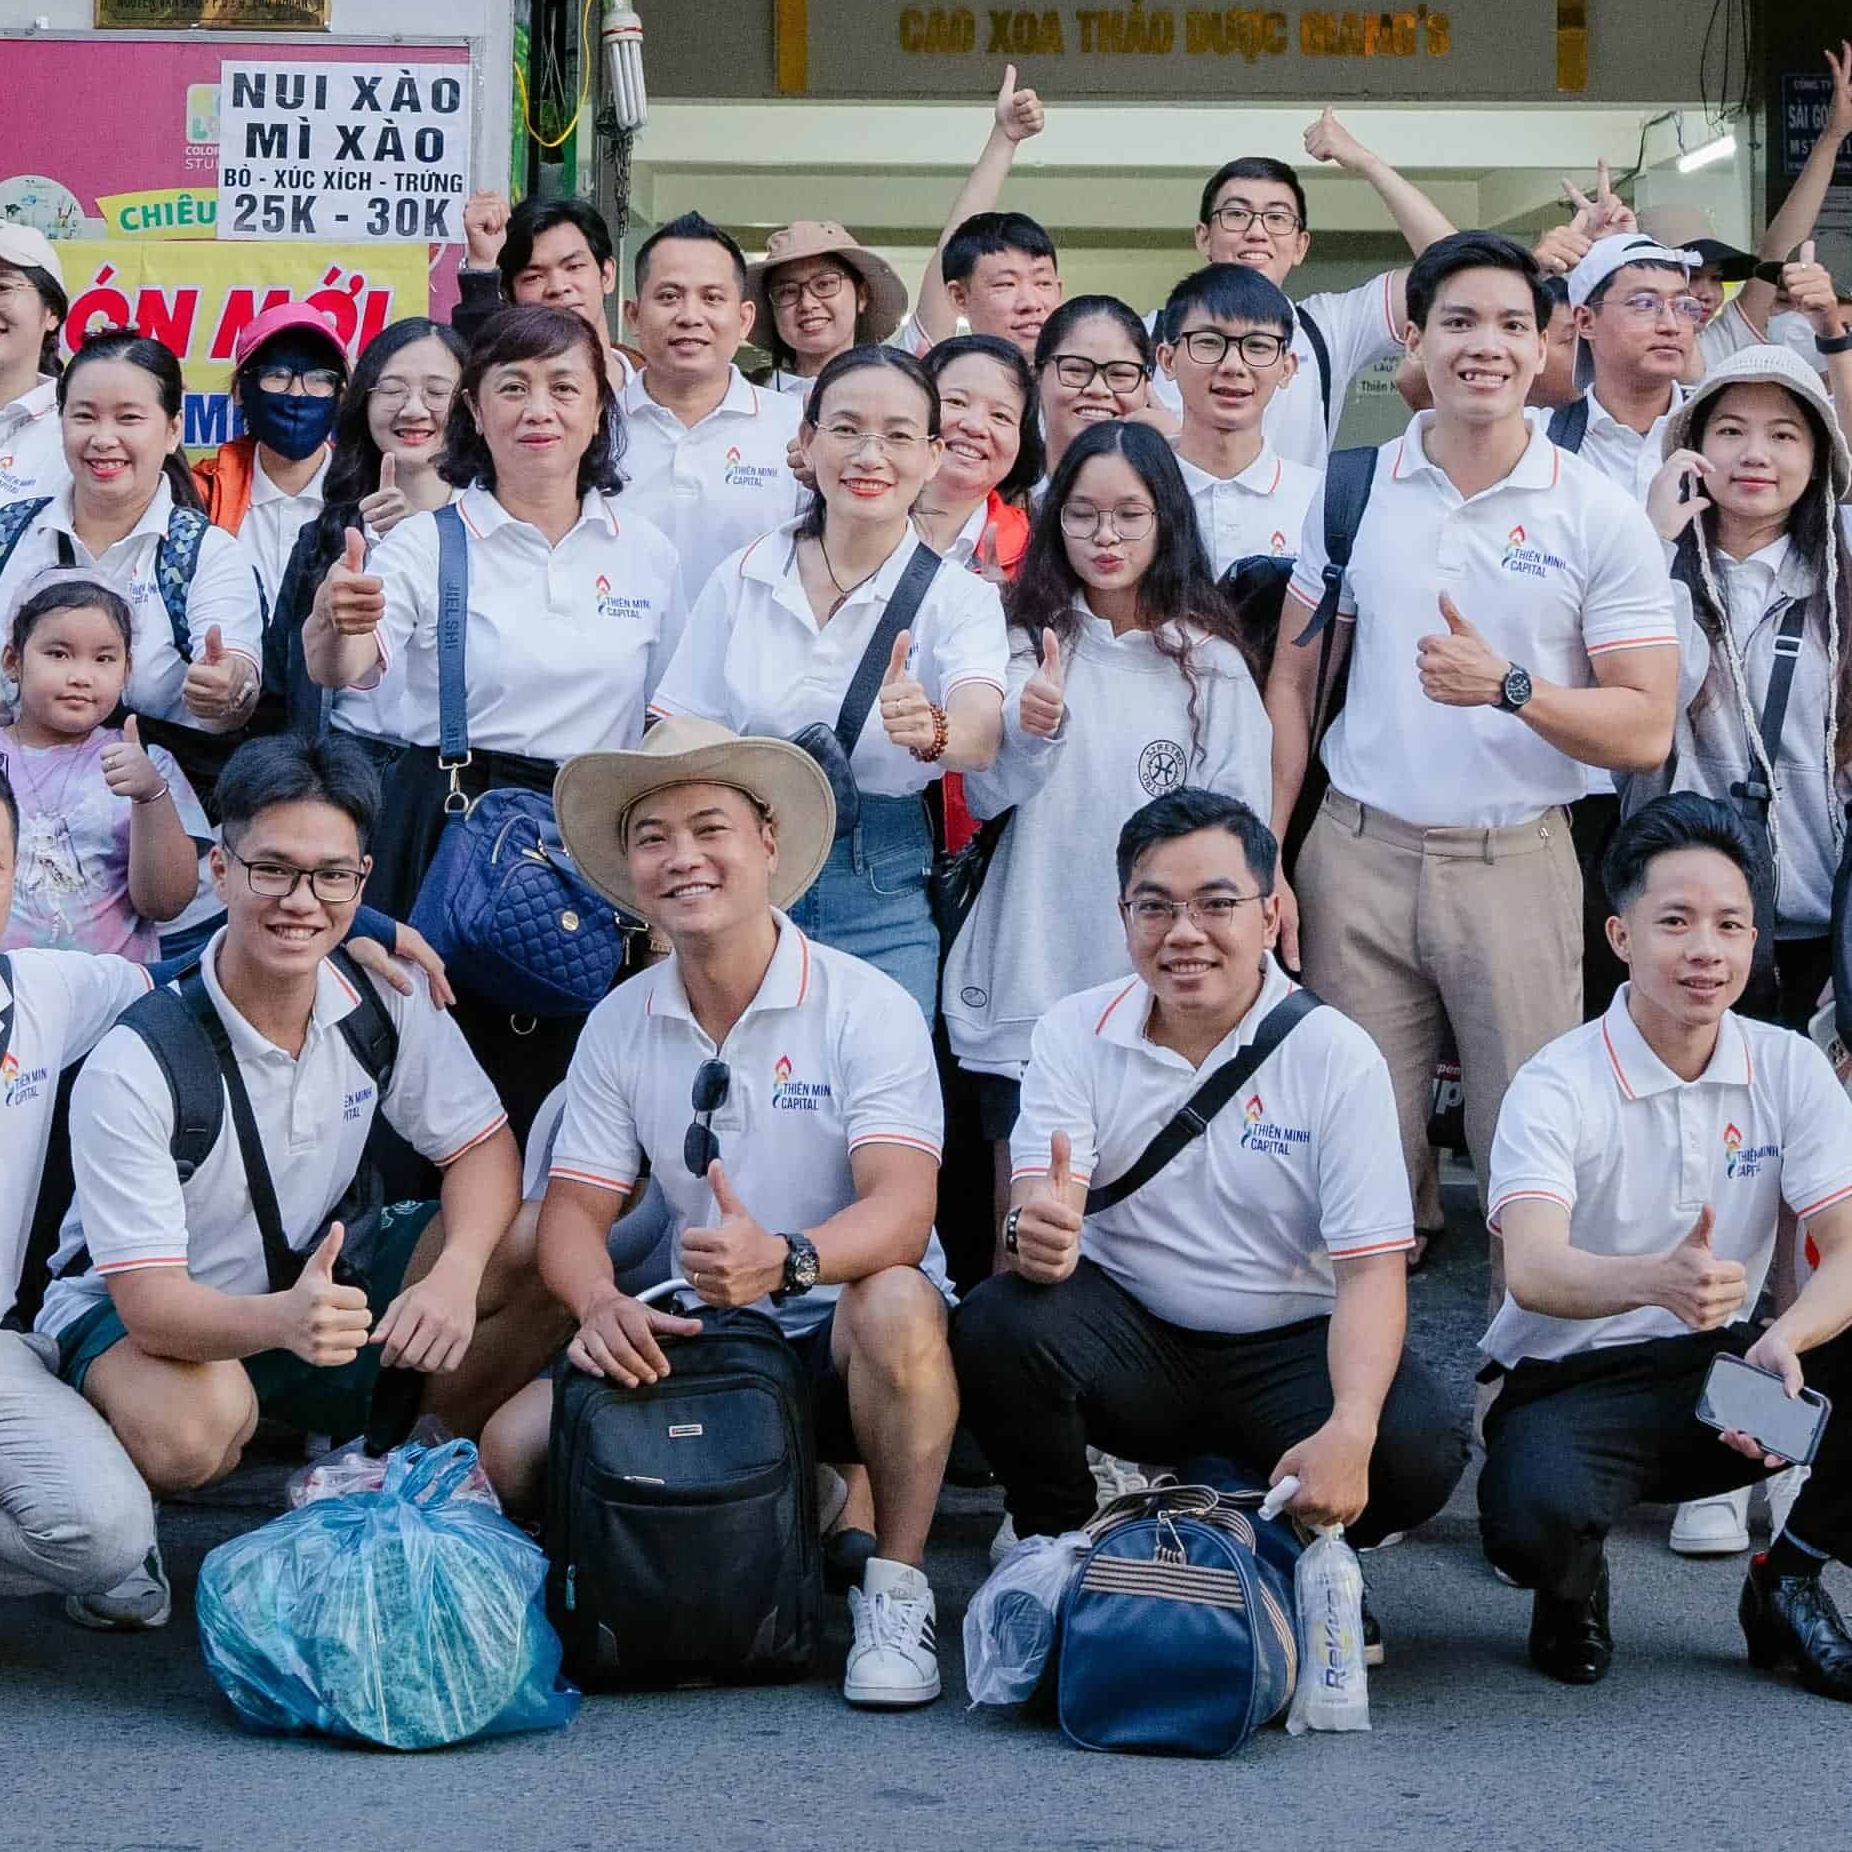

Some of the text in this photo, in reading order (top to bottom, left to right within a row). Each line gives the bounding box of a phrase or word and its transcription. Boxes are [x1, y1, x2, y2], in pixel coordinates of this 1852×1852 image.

[899, 4, 976, 56] CAO
[232, 68, 463, 114] NUI XÀO
[245, 115, 446, 163] MÌ XÀO
[223, 167, 464, 194] BÒ XÚC XÍCH TRỨNG
[233, 194, 451, 238] 25K 30K
[780, 1095, 820, 1111] CAPITAL
[1250, 1135, 1292, 1156] CAPITAL
[1253, 1122, 1311, 1144] THIÊN MINH
